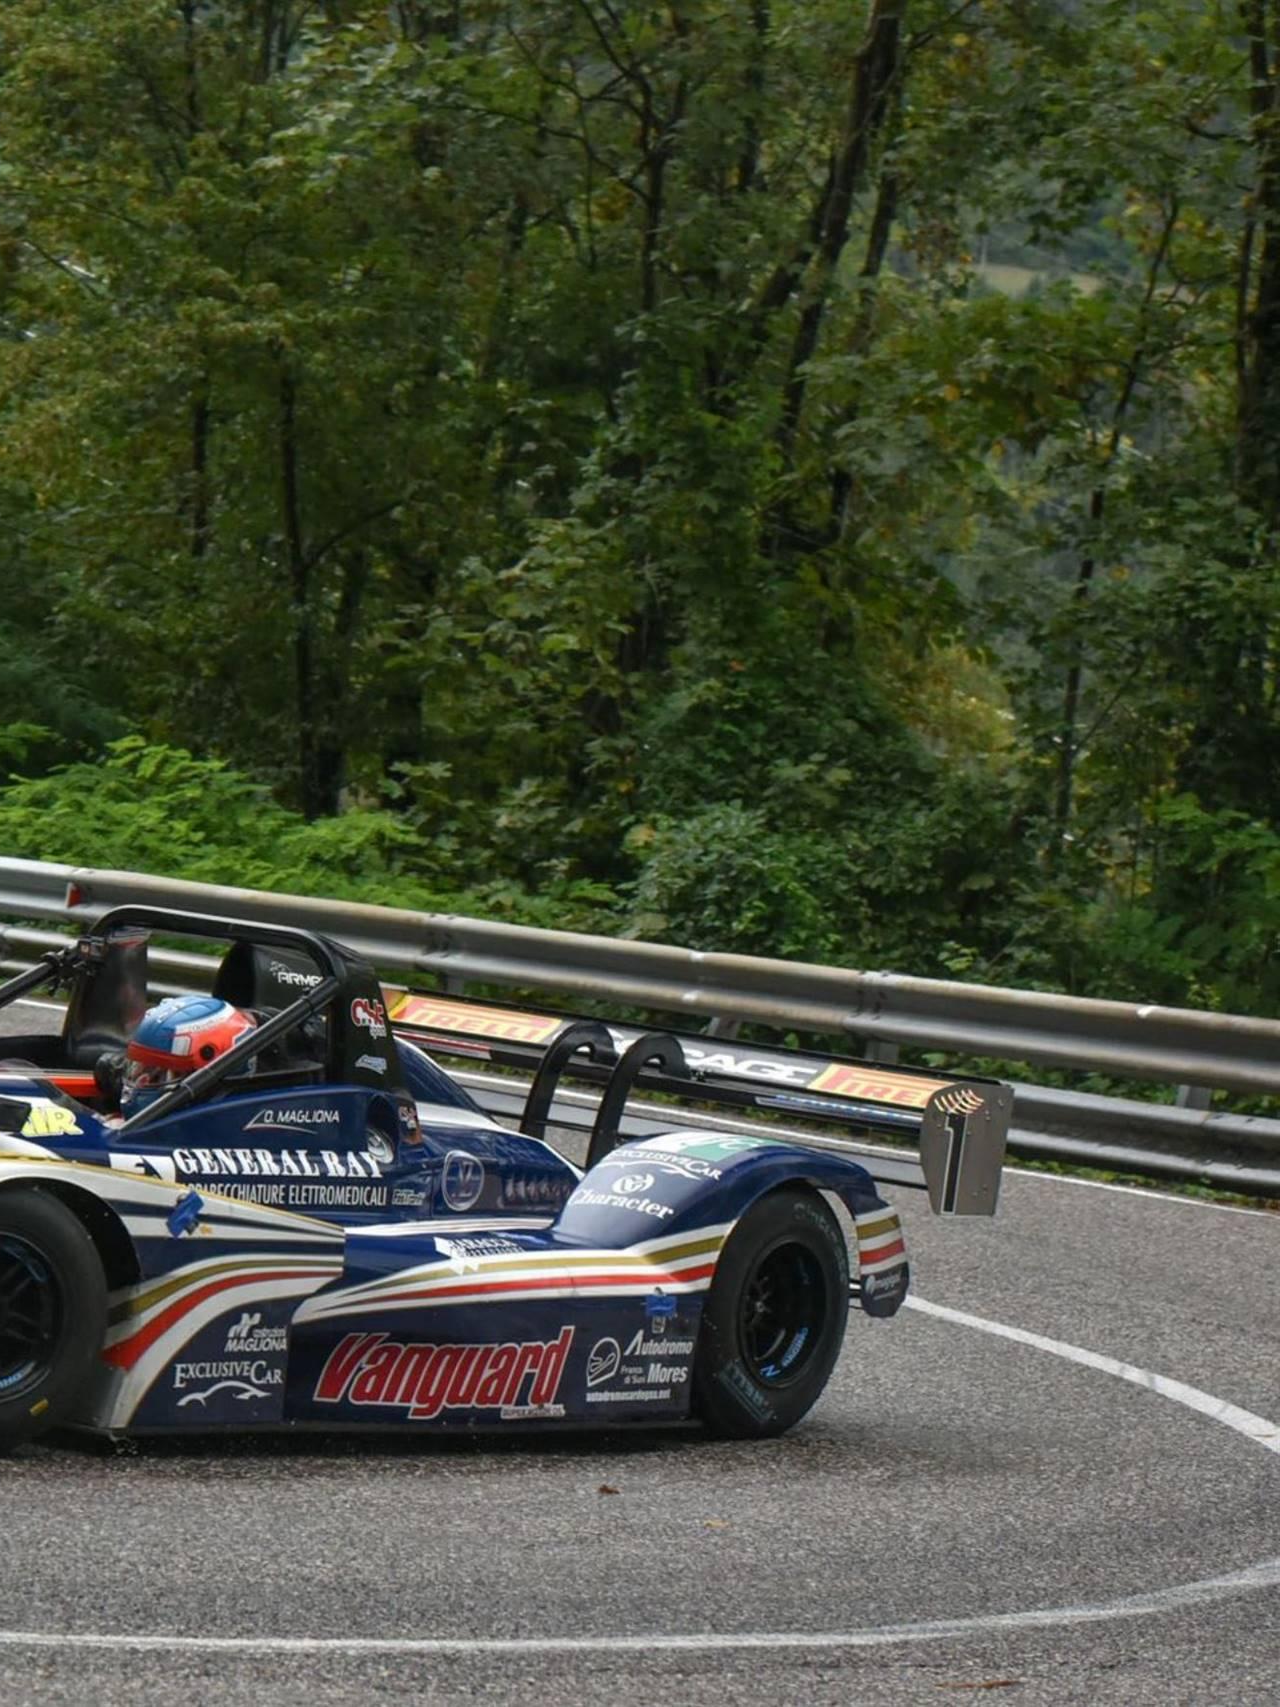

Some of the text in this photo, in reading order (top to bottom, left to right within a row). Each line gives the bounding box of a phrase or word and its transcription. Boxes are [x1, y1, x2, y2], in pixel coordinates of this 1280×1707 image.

[277, 1109, 340, 1124] MAGLIONA
[172, 1148, 384, 1179] GENERAL RAY
[288, 1184, 387, 1206] ELETTROMEDICALI
[570, 1188, 675, 1220] Character
[223, 1337, 288, 1353] MAGLIONA
[624, 1329, 694, 1356] Autodromo
[312, 1325, 576, 1421] Vanguard
[647, 1363, 689, 1384] Mores
